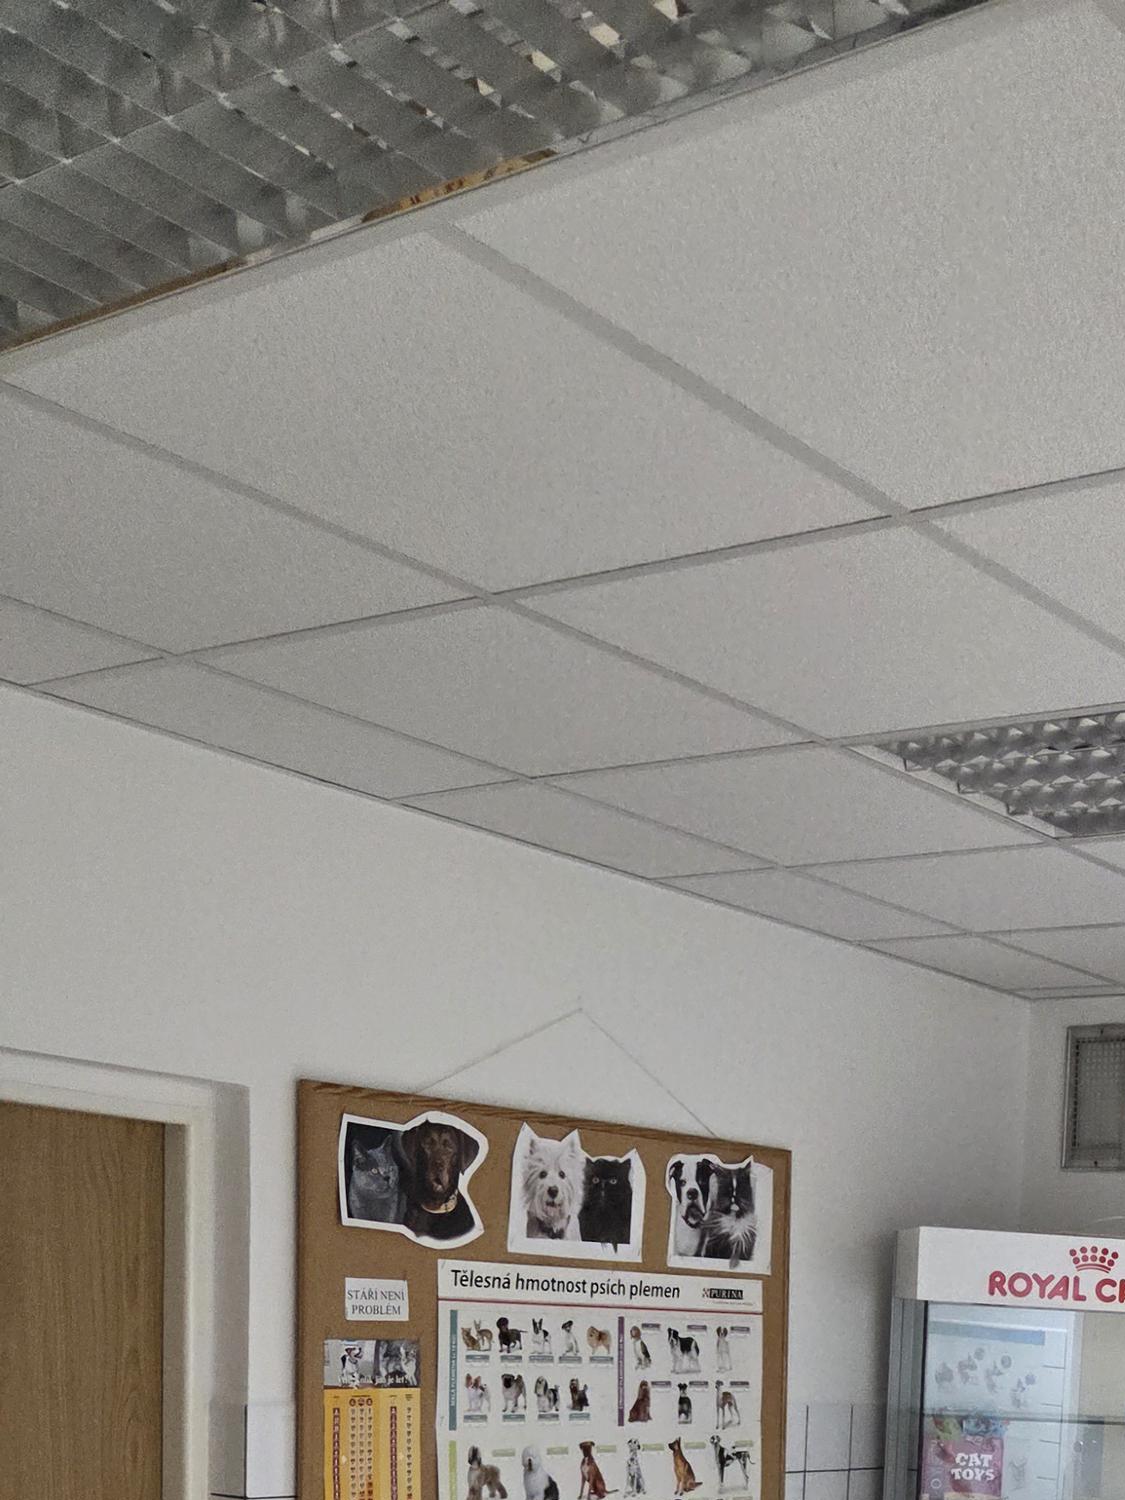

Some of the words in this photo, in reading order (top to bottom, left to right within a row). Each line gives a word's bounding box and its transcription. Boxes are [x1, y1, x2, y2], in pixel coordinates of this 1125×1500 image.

[450, 1269, 511, 1290] Tělesná
[515, 1272, 587, 1294] hmotnost
[590, 1278, 626, 1297] psích
[629, 1279, 681, 1300] plemen
[987, 1270, 1086, 1301] ROYAL
[347, 1287, 378, 1300] STÁŘÍ
[380, 1289, 405, 1301] NENÍ
[711, 1289, 743, 1300] PURINA
[351, 1302, 401, 1316] PROBLÉM
[955, 1452, 993, 1467] CAT
[950, 1468, 995, 1481] TOYS
